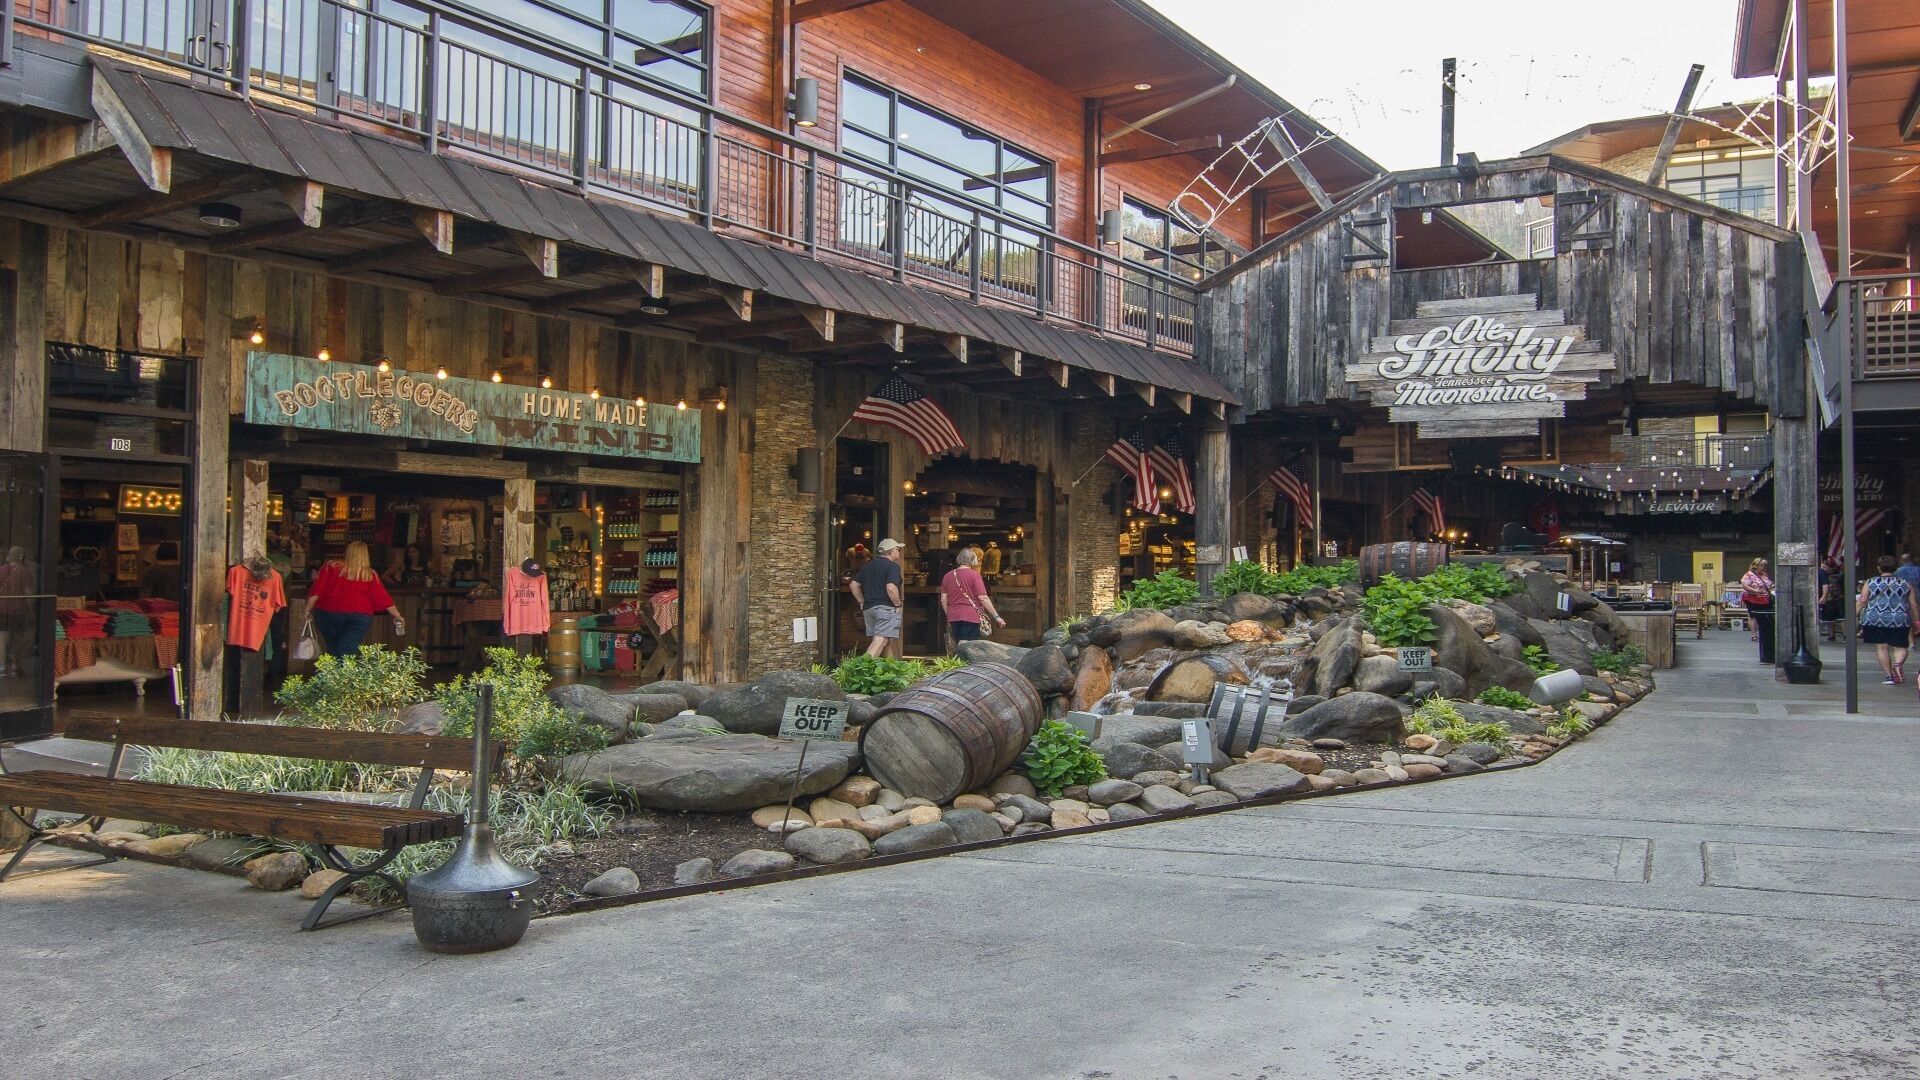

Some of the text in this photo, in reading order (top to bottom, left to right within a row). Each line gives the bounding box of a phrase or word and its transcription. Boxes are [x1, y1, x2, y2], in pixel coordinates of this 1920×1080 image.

[1451, 314, 1513, 344] Ole
[1377, 326, 1576, 382] Smoky
[1435, 376, 1494, 386] Tennessee
[1393, 379, 1558, 406] Moonshine
[274, 371, 479, 434] BOOTLEGGERS
[524, 392, 647, 427] HOME MADE
[488, 416, 674, 453] WINE
[113, 439, 130, 450] 108
[1649, 502, 1716, 512] ELEVATOR
[1403, 650, 1426, 658] KEEP
[1404, 658, 1425, 666] OUT
[795, 704, 839, 719] KEEP
[794, 718, 833, 731] OUT
